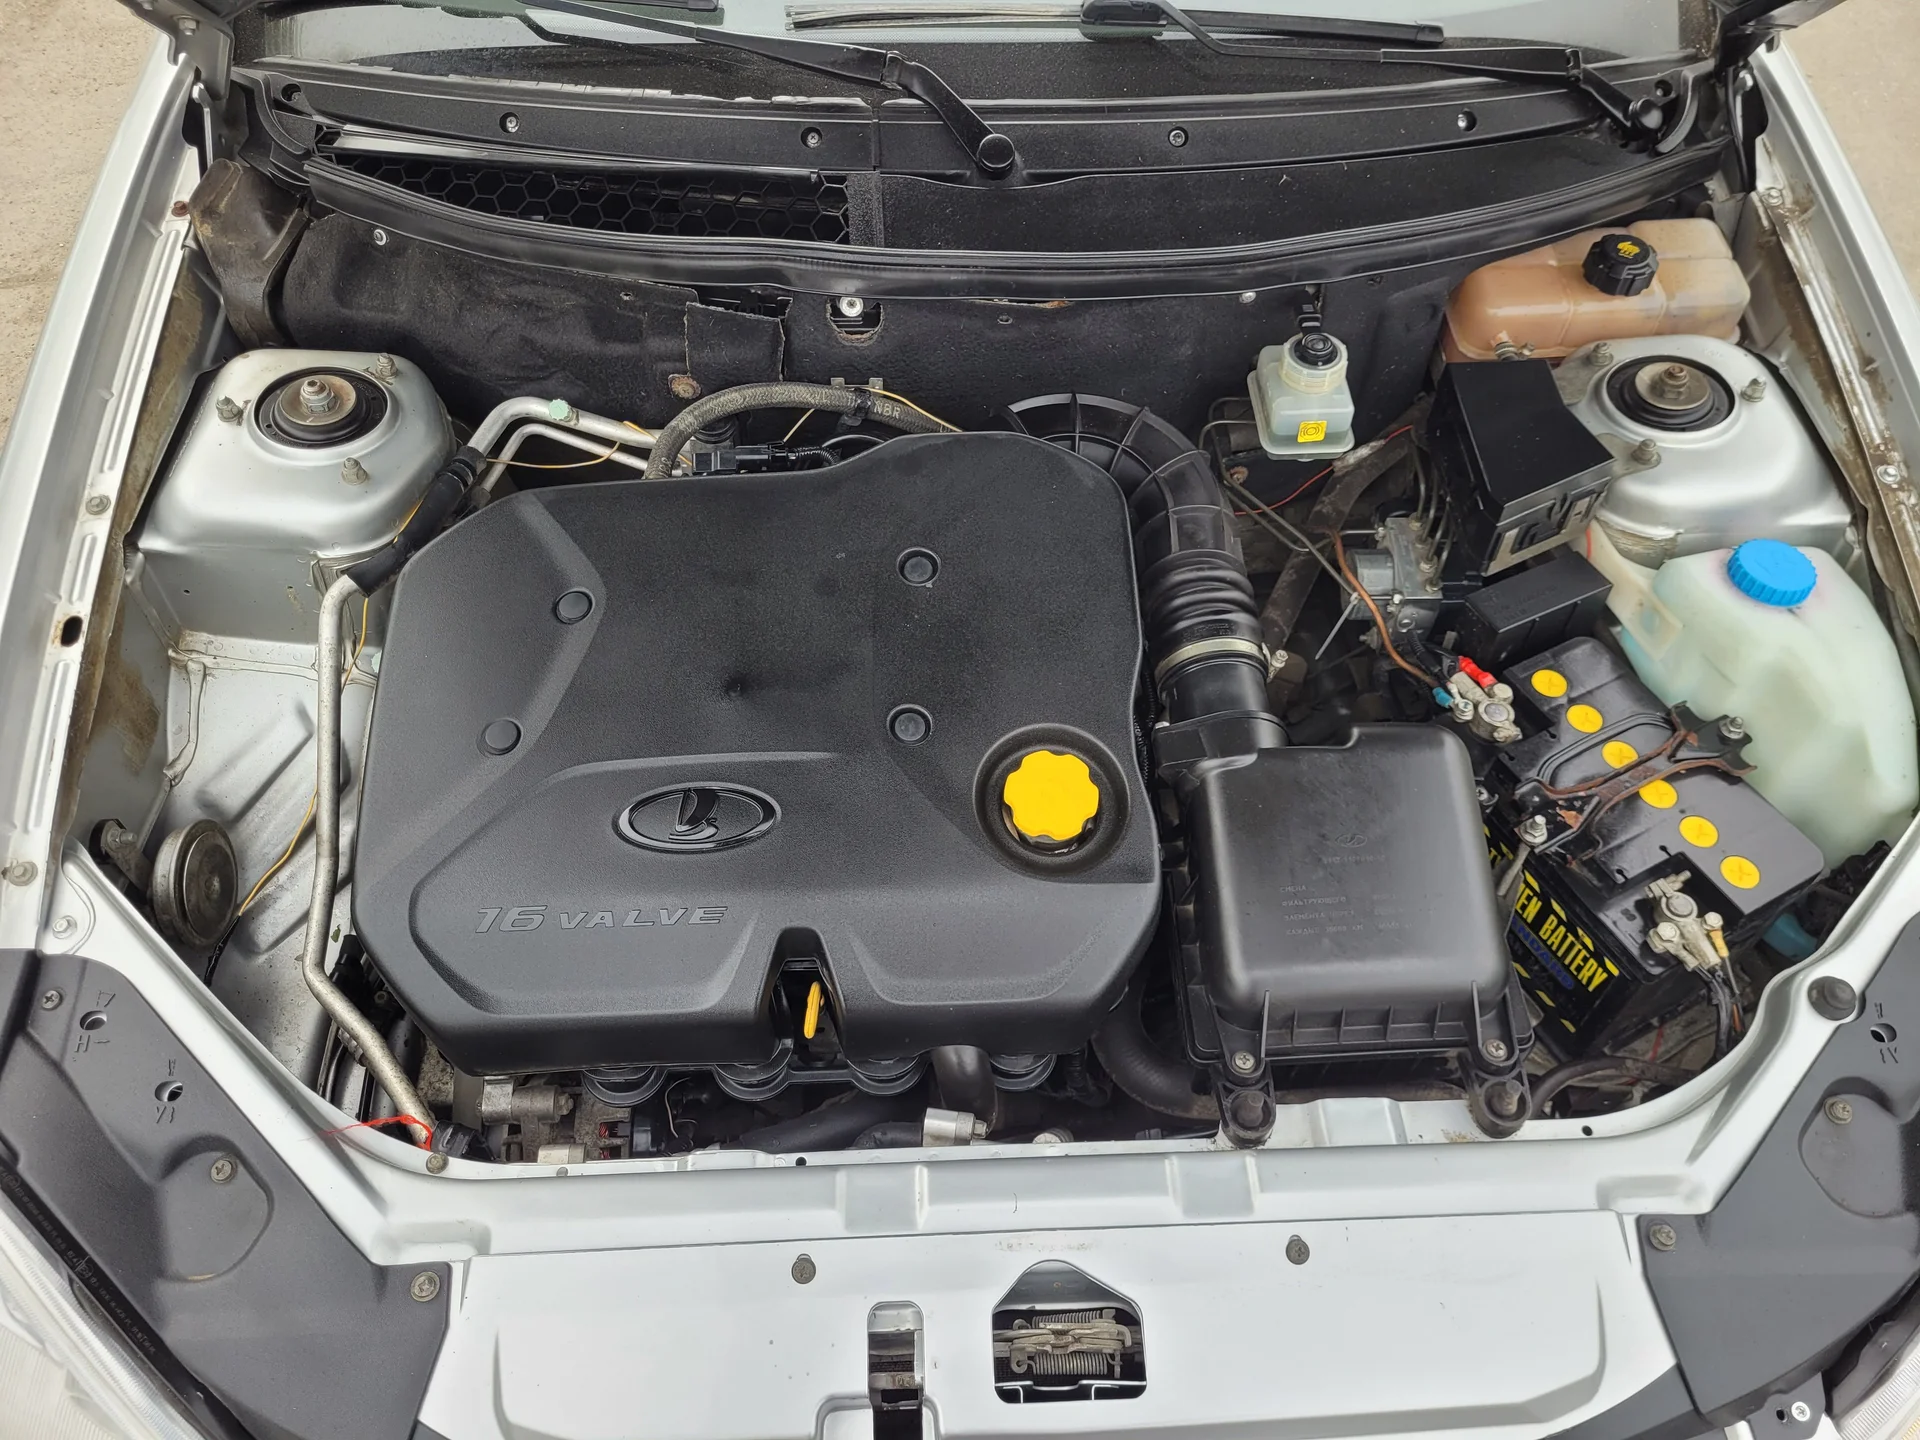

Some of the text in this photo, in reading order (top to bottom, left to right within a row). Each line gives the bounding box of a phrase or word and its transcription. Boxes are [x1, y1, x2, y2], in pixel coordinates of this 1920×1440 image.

[475, 904, 729, 934] 16 VALVE
[1538, 914, 1609, 992] BATTERY
